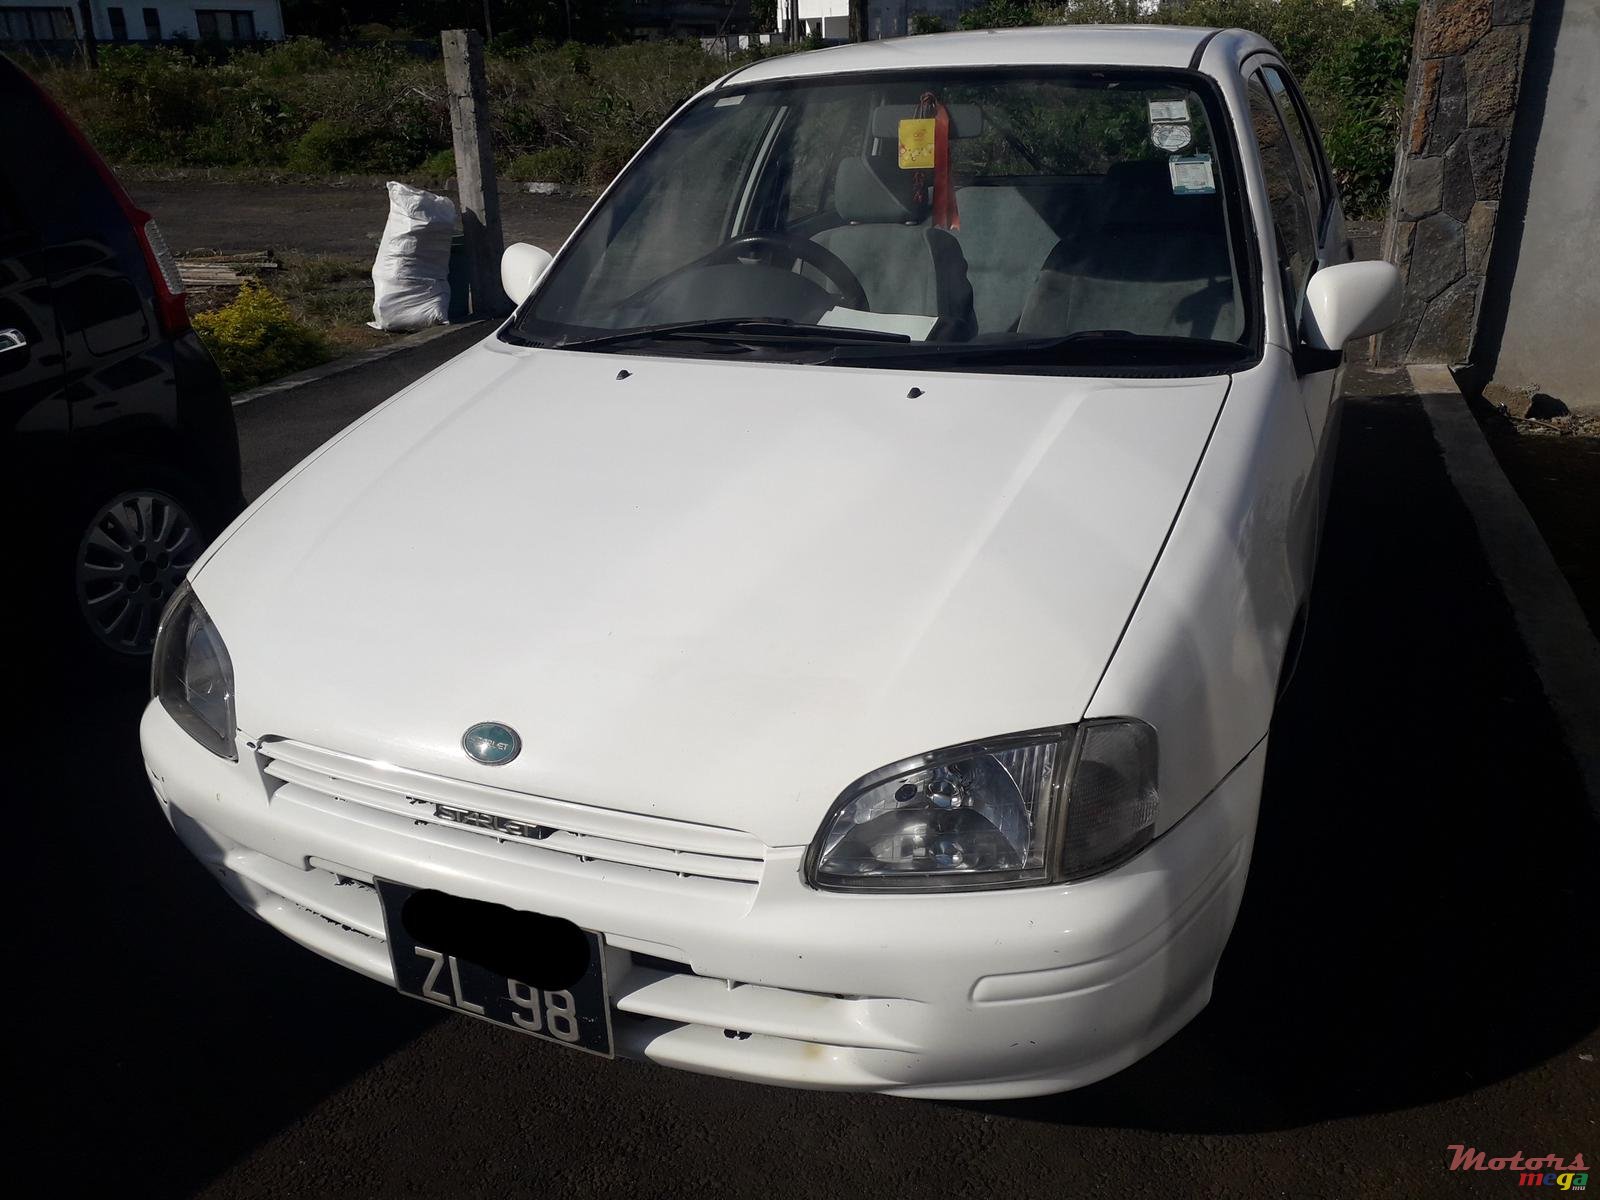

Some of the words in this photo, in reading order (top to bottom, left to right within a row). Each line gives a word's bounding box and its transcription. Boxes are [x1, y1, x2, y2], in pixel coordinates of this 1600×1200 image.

[436, 805, 537, 837] STARLET
[414, 946, 485, 1015] ZL
[508, 978, 580, 1042] 98
